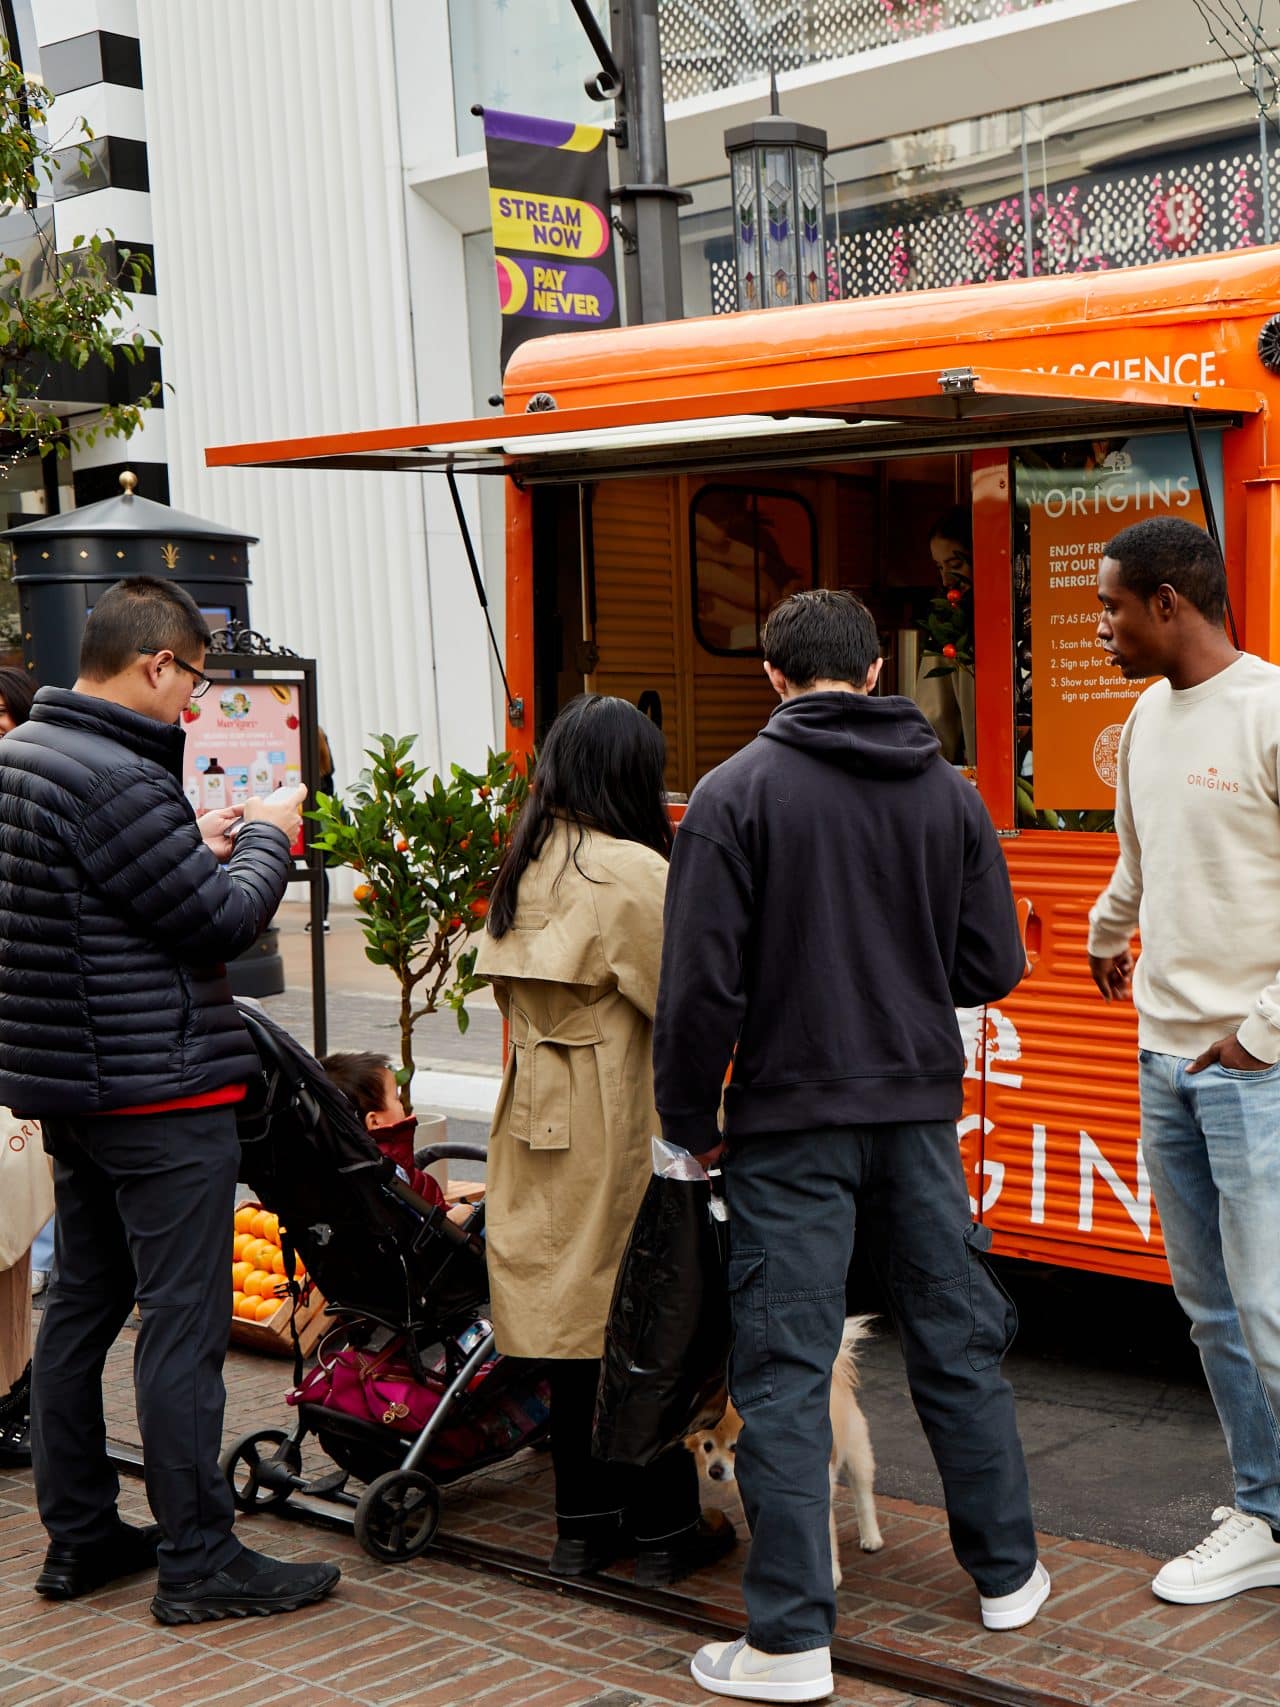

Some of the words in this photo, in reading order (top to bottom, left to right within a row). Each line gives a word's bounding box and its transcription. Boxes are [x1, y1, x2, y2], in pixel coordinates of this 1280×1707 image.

[498, 197, 581, 228] STREAM
[532, 224, 582, 250] NOW
[532, 266, 567, 291] PAY
[533, 289, 601, 317] NEVER
[1043, 476, 1191, 518] ORIGINS
[1049, 543, 1085, 557] ENJOY
[1049, 561, 1067, 573] TRY
[1070, 559, 1096, 572] OUR
[1049, 574, 1099, 589] ENERGIZ
[1050, 614, 1065, 625] IT'S
[1066, 614, 1078, 624] AS
[1051, 640, 1058, 650] 1.
[1059, 639, 1079, 649] Scan
[1080, 638, 1092, 648] the
[1050, 659, 1059, 669] 2.
[1060, 658, 1078, 671] Sign
[1079, 660, 1090, 671] up
[1091, 656, 1102, 667] for
[1050, 678, 1059, 688] 3.
[1060, 677, 1082, 688] Show
[1083, 678, 1097, 686] our
[1099, 675, 1127, 686] Barista
[1061, 691, 1078, 703] sign
[1079, 692, 1089, 702] up
[1187, 774, 1240, 793] ORIGINS
